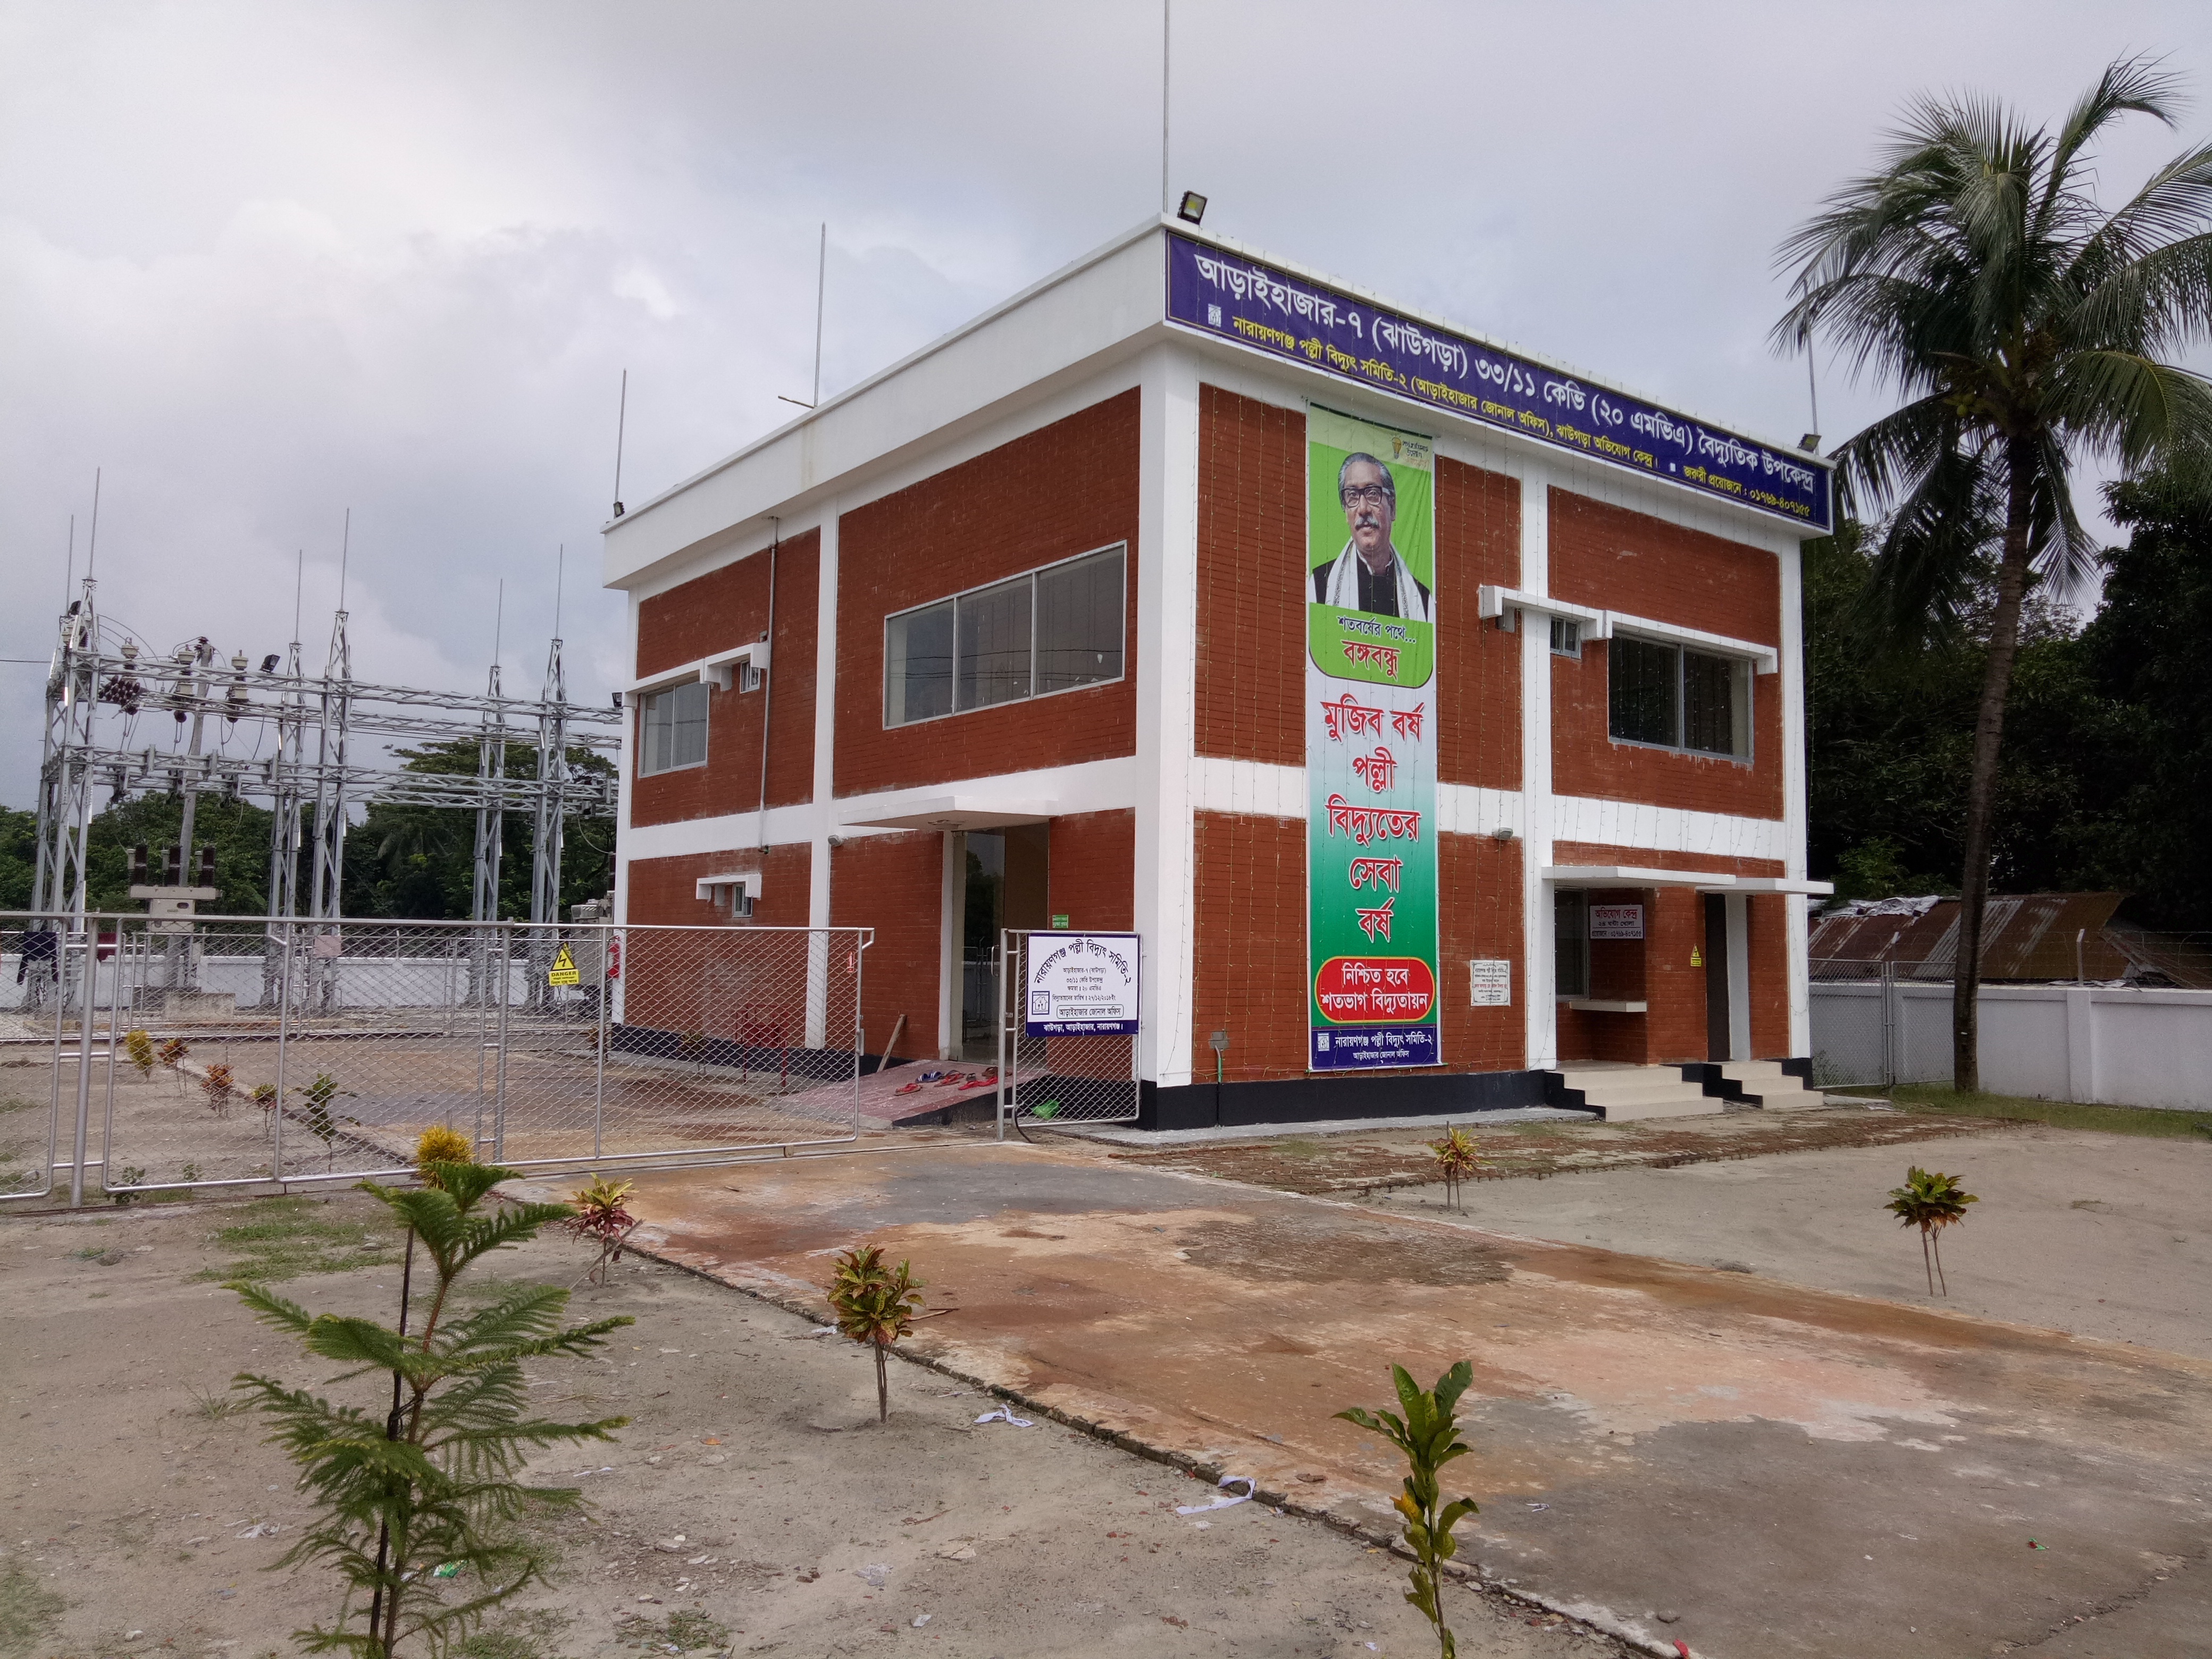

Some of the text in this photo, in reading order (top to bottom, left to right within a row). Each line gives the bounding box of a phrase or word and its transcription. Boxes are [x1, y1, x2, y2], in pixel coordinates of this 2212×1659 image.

[1194, 254, 1815, 494] আড়াইহাজার-৭ (ঝাউগড়া) ৩৩/১১ কেভি (২০ এমভিএ) বৈদ্যুতিক উপকেন্দ্র
[1232, 316, 1295, 351] নারায়ণগঞ্জ
[1299, 338, 1323, 360] পল্লী
[1326, 343, 1358, 372] বিদ্যুৎ
[1360, 358, 1407, 390] সমিতি-২
[1411, 375, 1478, 410] (আড়াইহাজার
[1481, 400, 1515, 422] জোনাল
[1556, 424, 1591, 448] ঝাউগড়া
[1594, 435, 1631, 459] অভিযোগ
[1337, 616, 1417, 643] শতবর্ষের পথে...
[1340, 640, 1401, 682] বঙ্গবন্ধু
[1320, 693, 1426, 744] মুজিব বর্ষ
[1352, 747, 1398, 793] পল্লী
[1325, 793, 1422, 848] বিদ্যুতের
[1349, 854, 1403, 893] সেবা
[1355, 897, 1395, 943] বর্ষ
[1595, 907, 1637, 919] অভিযোগ কেন্দ্র
[1034, 939, 1132, 986] নারায়ণগঞ্জ পল্লী বিদ্যুৎ সমিতি-২
[1341, 962, 1409, 987] নিশ্চিত হবে
[1059, 1007, 1087, 1017] আড়াইহাজার
[1107, 1006, 1121, 1016] অফিস
[1320, 987, 1429, 1015] শতভাগ বিদ্যুতায়ন
[1335, 1031, 1432, 1048] নারায়ণগঞ্জ পল্লী বিদ্যুৎ সমিতি-২
